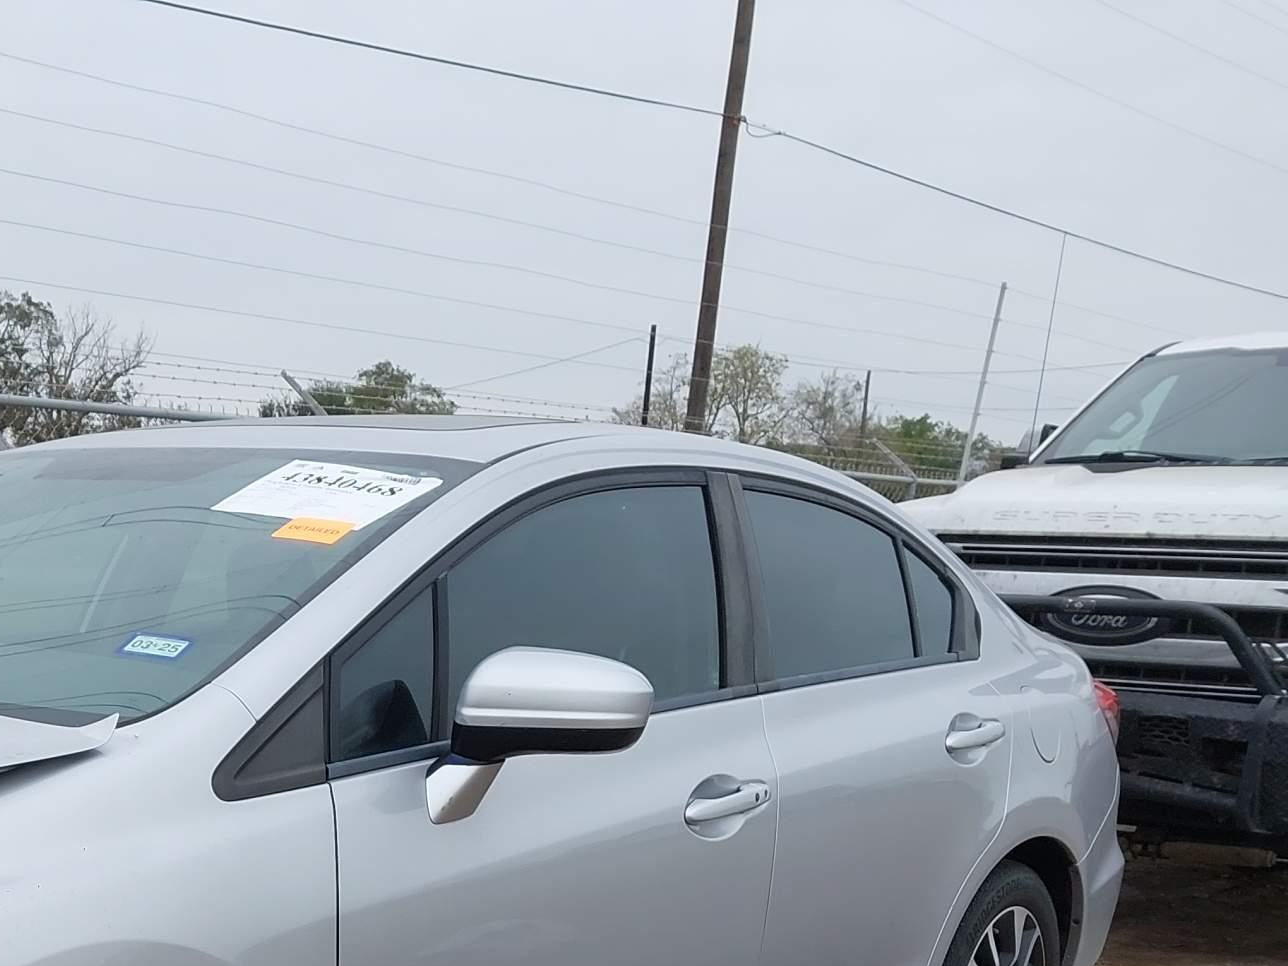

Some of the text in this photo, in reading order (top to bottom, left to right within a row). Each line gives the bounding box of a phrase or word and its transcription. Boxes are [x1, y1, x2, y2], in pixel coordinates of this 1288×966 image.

[283, 473, 403, 496] 43840468
[992, 510, 1282, 524] SUPER DUTY
[288, 525, 340, 535] DETAILED
